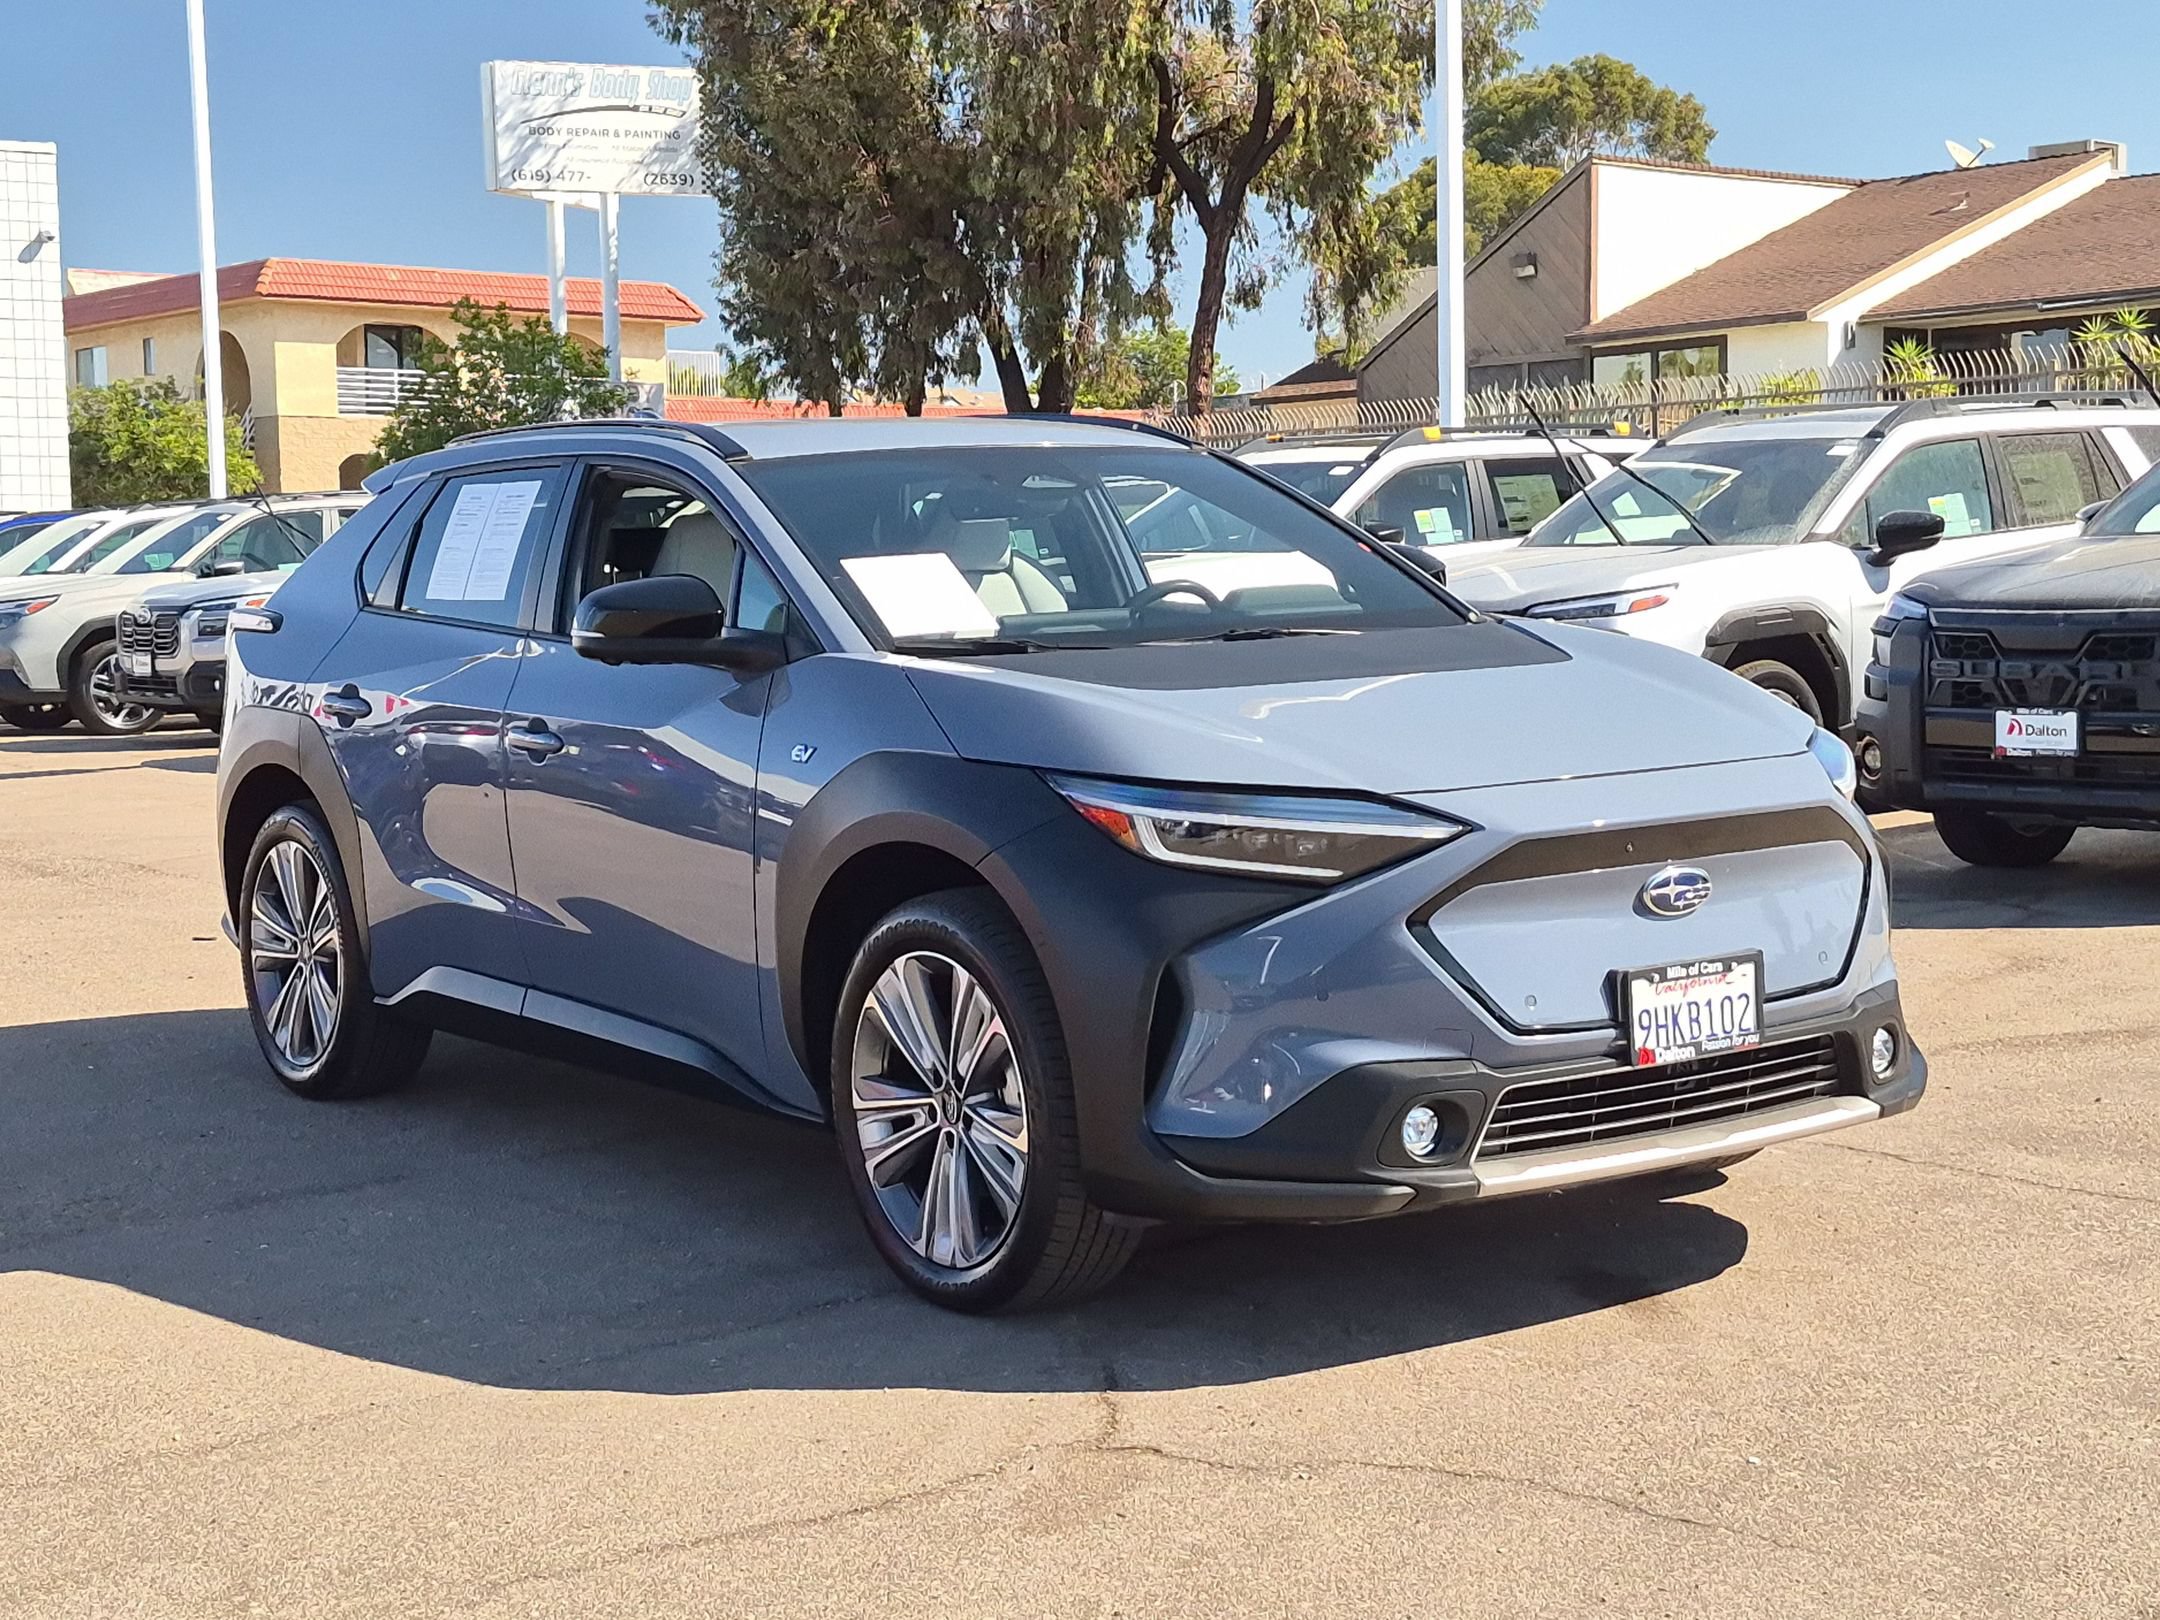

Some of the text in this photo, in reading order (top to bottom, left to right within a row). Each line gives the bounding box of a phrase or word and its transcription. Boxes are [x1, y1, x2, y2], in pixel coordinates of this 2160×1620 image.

[511, 65, 693, 107] Glenn's Body Shop
[529, 126, 681, 139] BODY REPAIR & PAINTING
[511, 169, 551, 182] (619)
[643, 172, 694, 187] (2639)
[2025, 724, 2067, 737] Dalton
[791, 744, 818, 764] EV
[1688, 962, 1699, 975] of
[1700, 962, 1724, 974] Cars
[1639, 993, 1751, 1048] 9HKB102
